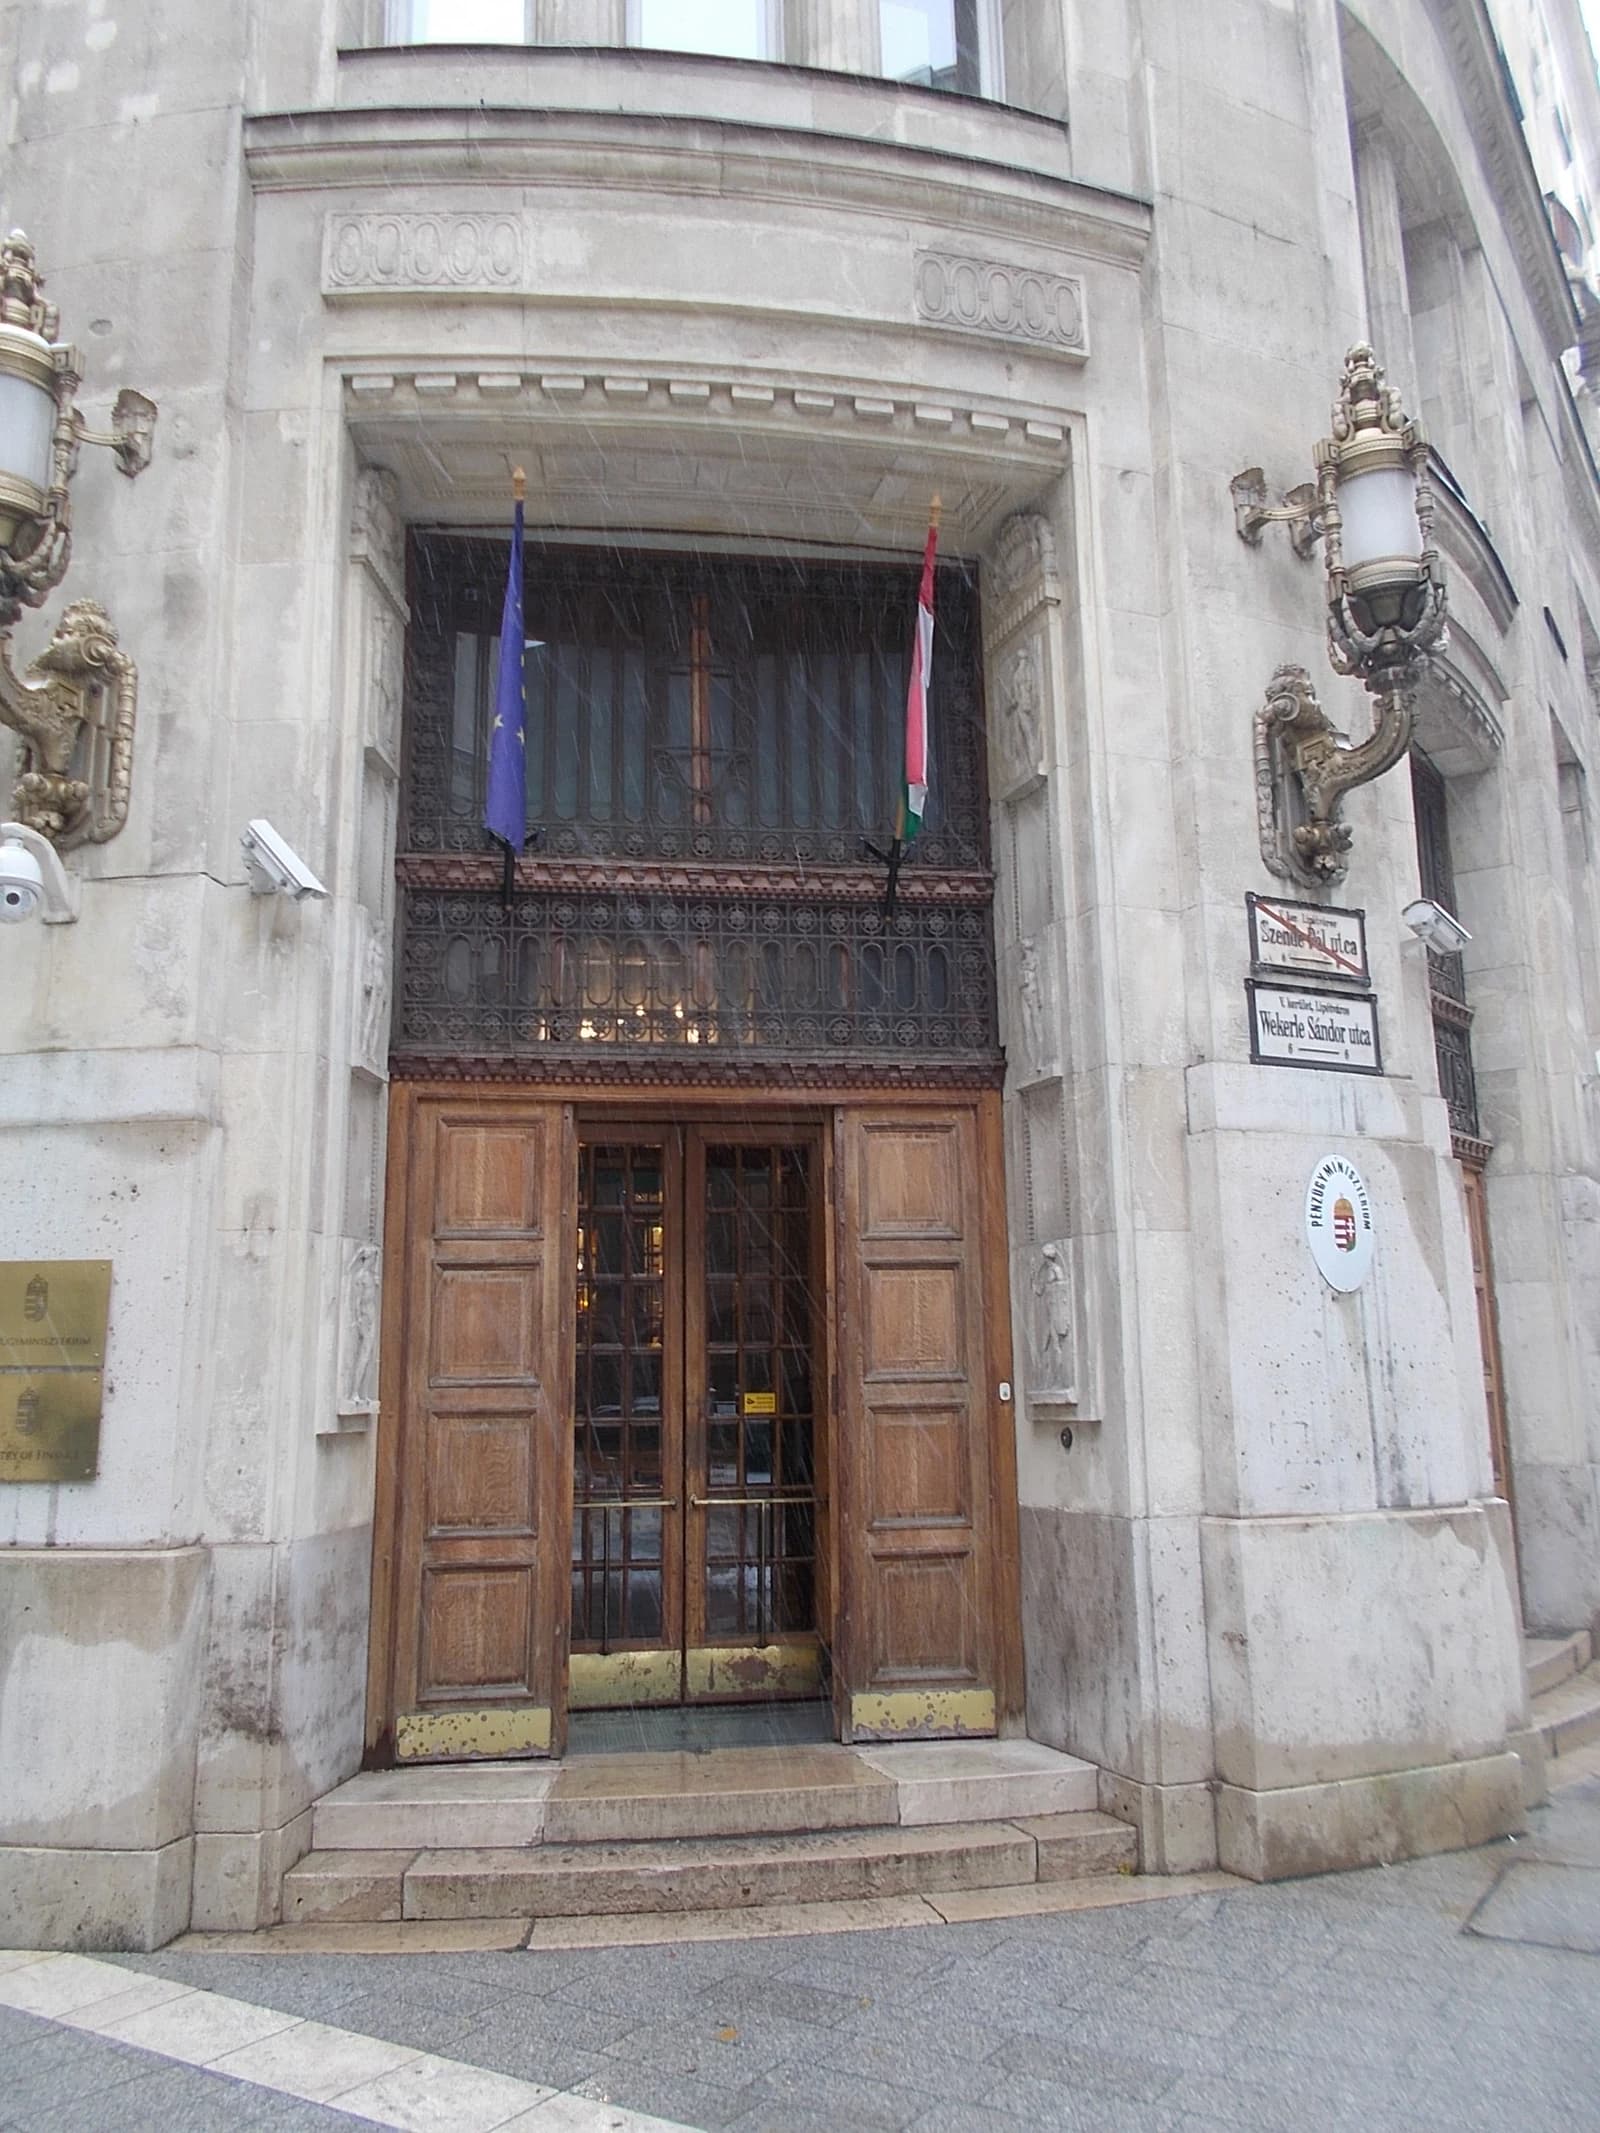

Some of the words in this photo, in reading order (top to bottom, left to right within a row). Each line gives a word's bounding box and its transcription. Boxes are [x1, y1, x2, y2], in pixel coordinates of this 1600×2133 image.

[1330, 932, 1358, 956] utca
[1259, 1010, 1305, 1039] Wekerle
[1307, 1015, 1346, 1044] Sándor
[1348, 1022, 1372, 1046] utca
